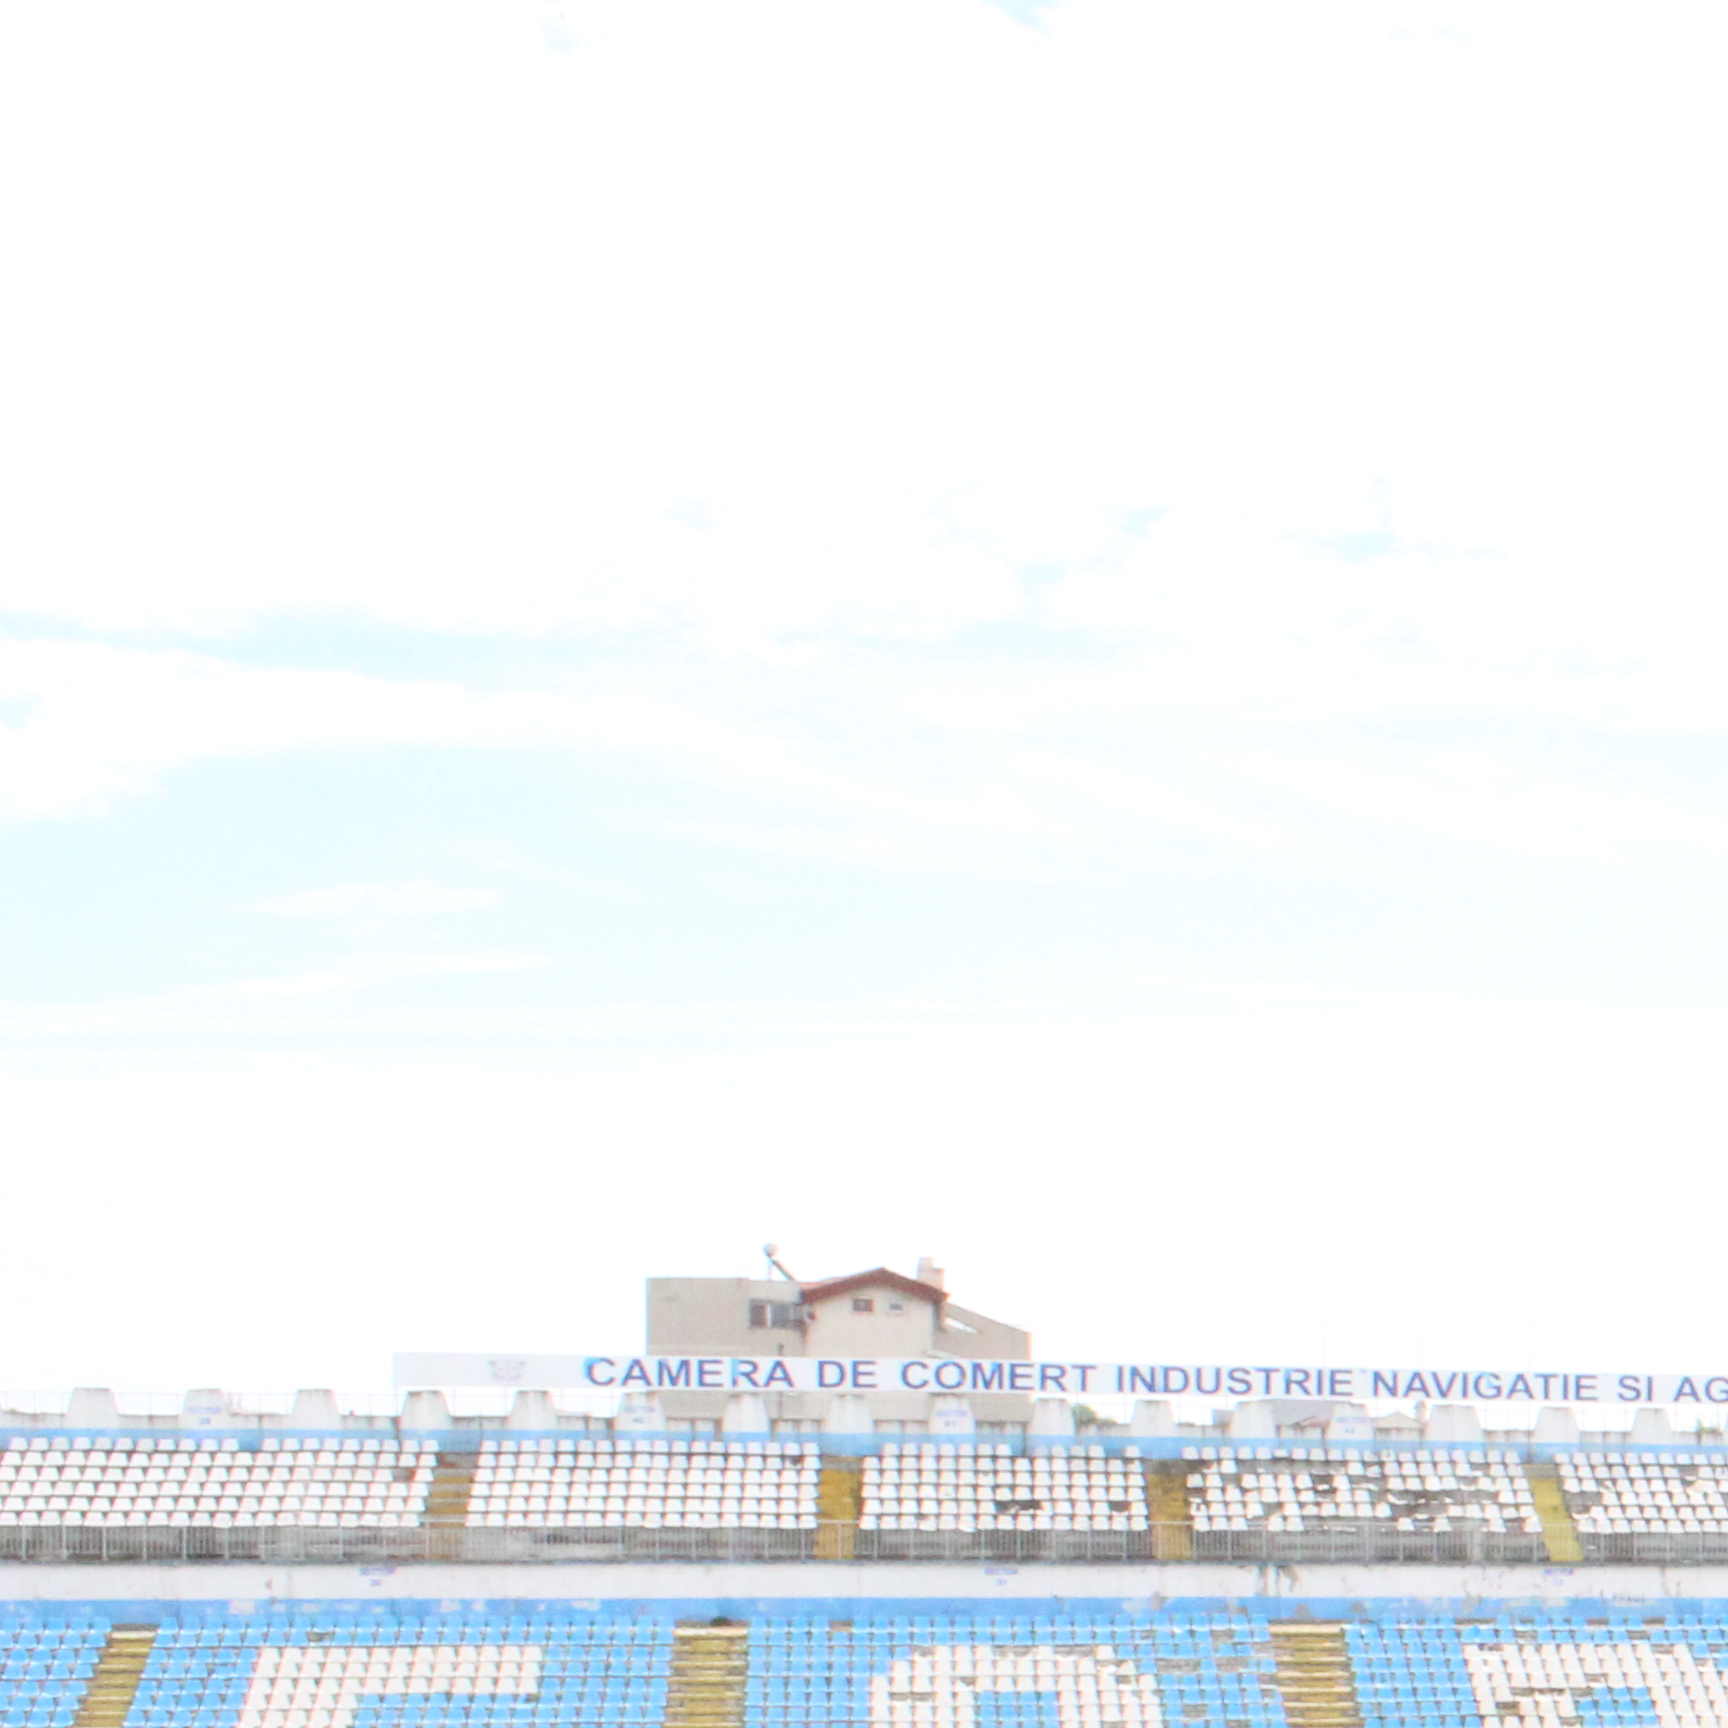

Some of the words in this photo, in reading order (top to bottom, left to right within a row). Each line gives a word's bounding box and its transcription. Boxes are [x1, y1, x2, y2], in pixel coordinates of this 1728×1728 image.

[585, 1356, 796, 1389] CAMERA
[815, 1359, 878, 1390] DE
[900, 1360, 1098, 1393] COMERT
[1117, 1364, 1354, 1397] INDUSTRIE
[1371, 1370, 1598, 1401] NAVIGATIE
[1616, 1373, 1654, 1402] SI
